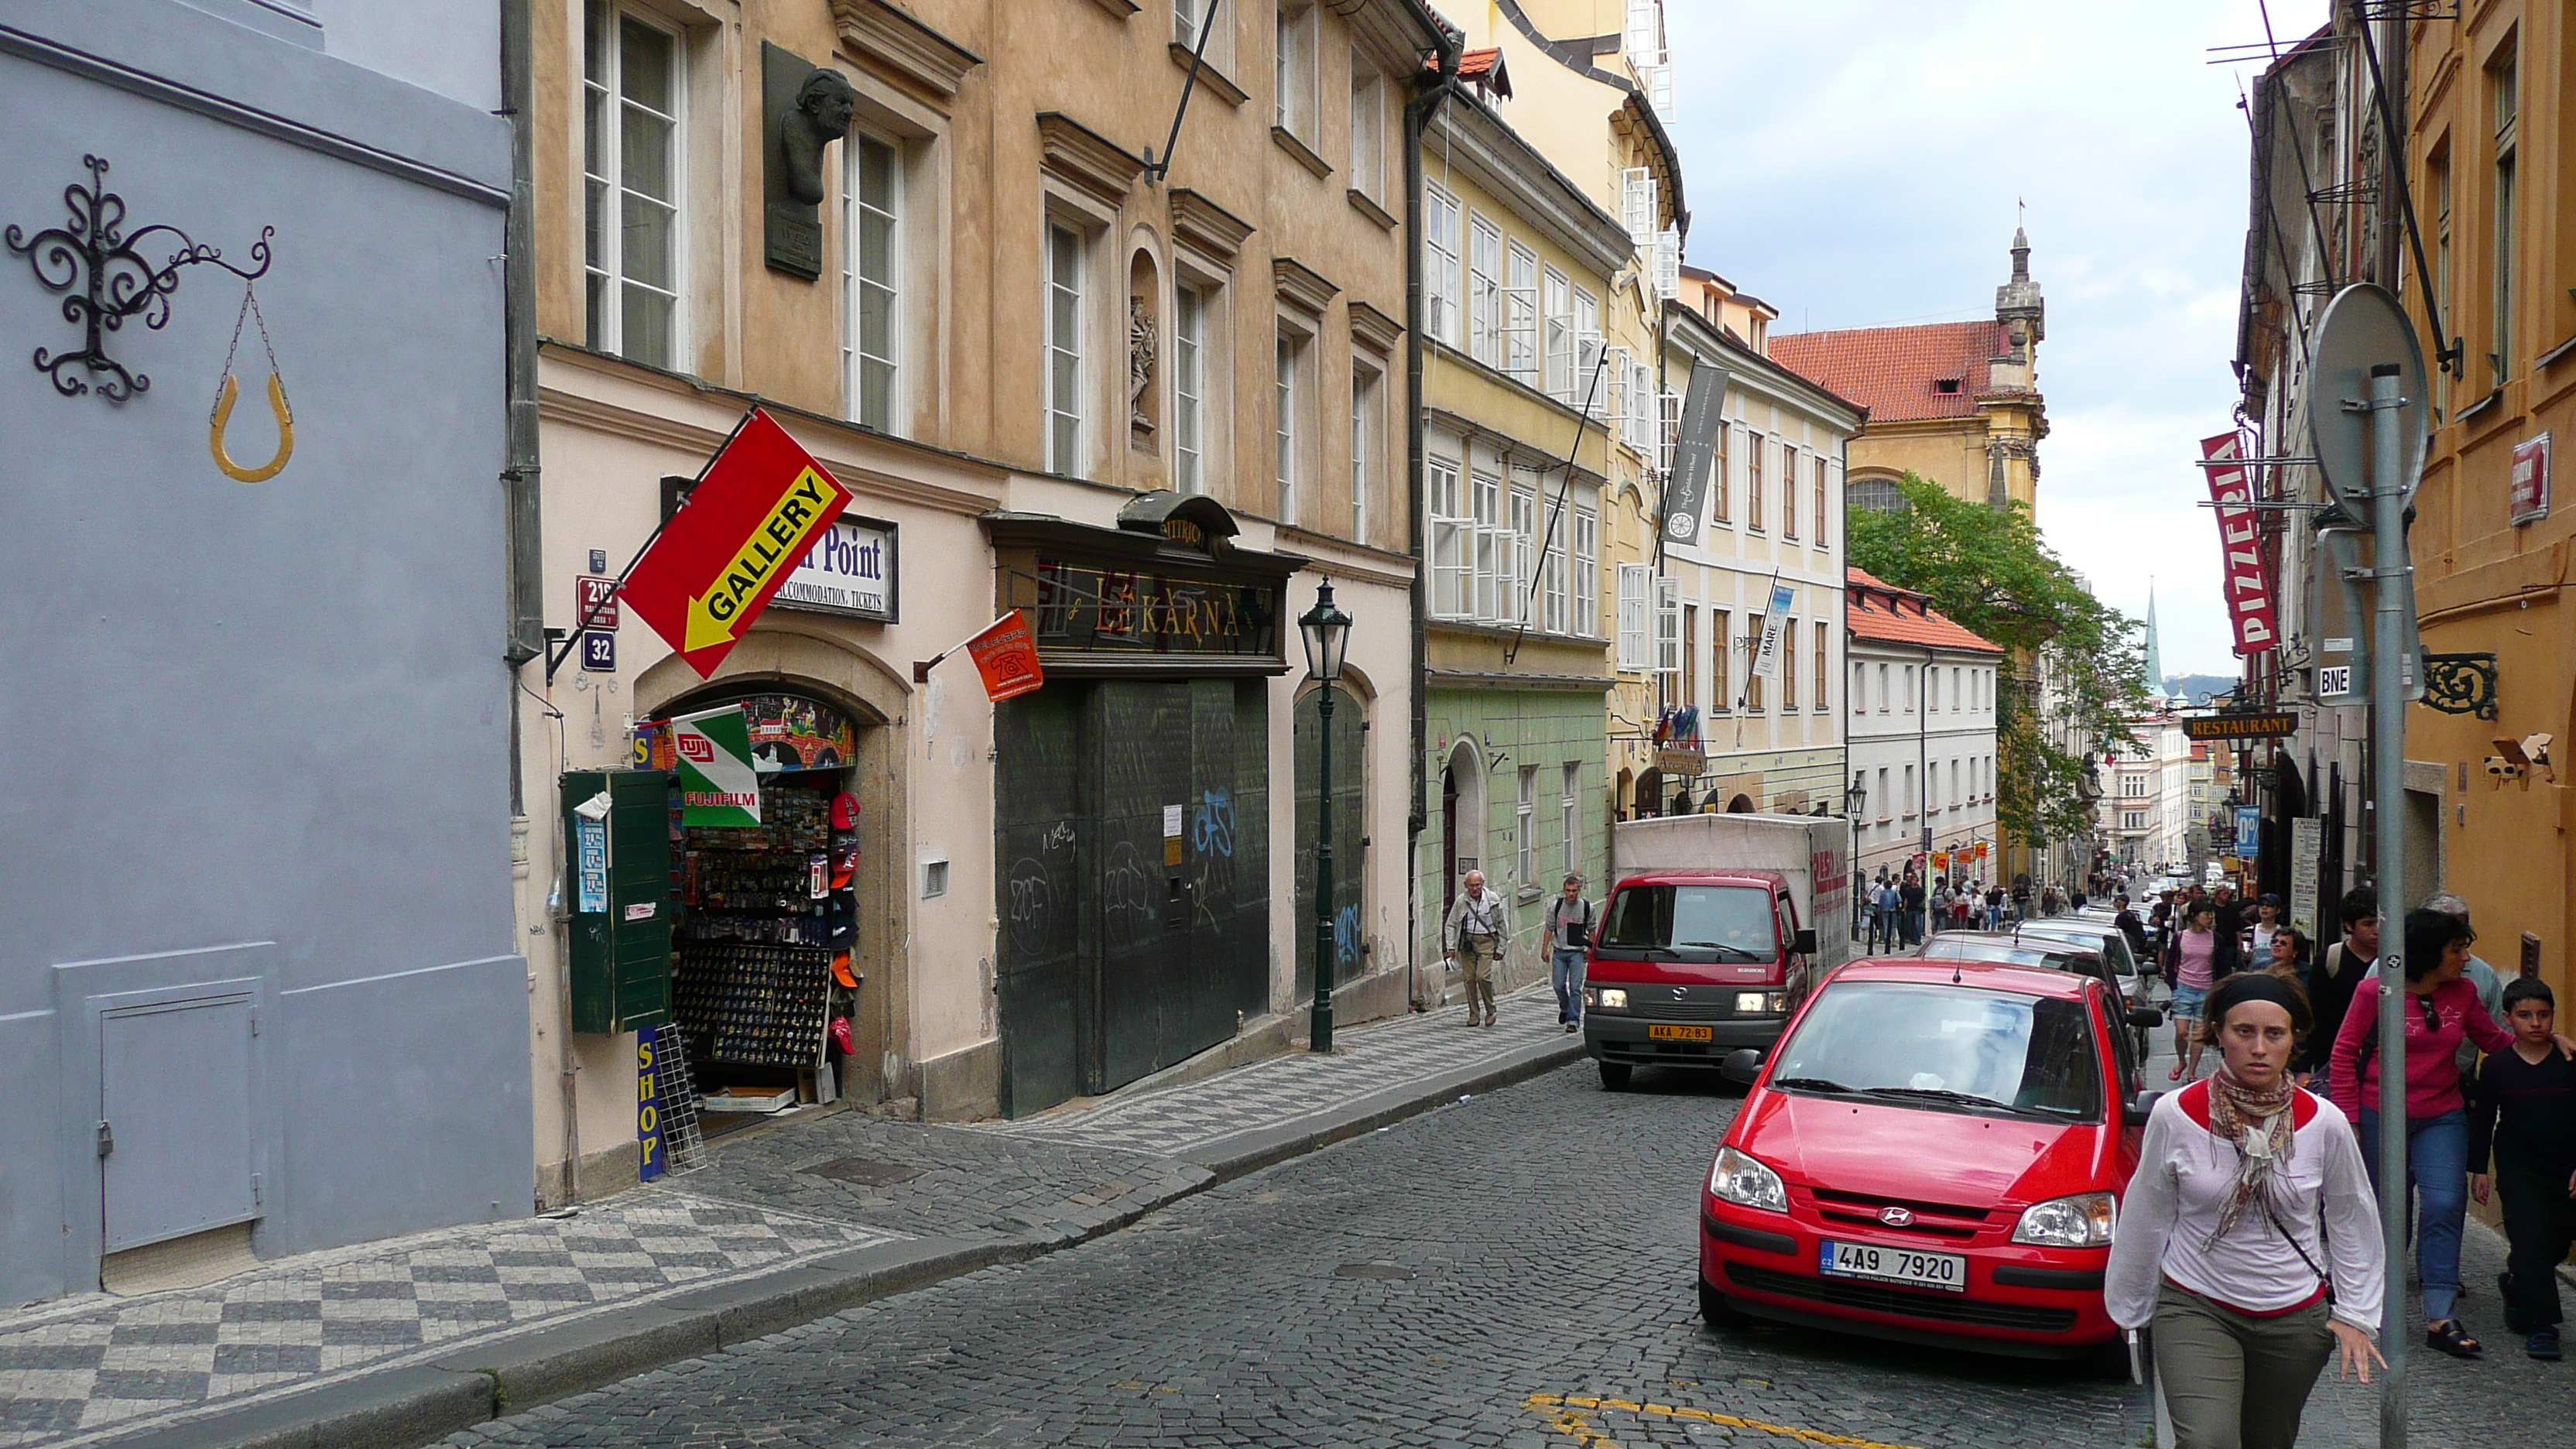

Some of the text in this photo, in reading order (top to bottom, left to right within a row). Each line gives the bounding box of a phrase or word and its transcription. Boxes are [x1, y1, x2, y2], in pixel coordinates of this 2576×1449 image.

[708, 474, 823, 621] GALLERY
[824, 524, 881, 580] Point
[2209, 439, 2270, 643] PIZZERIA
[777, 581, 882, 610] ACCOMMODATION, TICKETS
[592, 639, 610, 660] 32
[1762, 624, 1777, 656] MARE
[2321, 669, 2348, 694] BNE
[2192, 718, 2290, 735] RESTAURANT
[685, 792, 755, 807] FUJIFILM
[2239, 817, 2259, 844] 0%
[1654, 1026, 1707, 1038] AKA 72-83
[639, 1042, 657, 1166] SHOP
[1839, 1246, 1954, 1281] 4A9 7920
